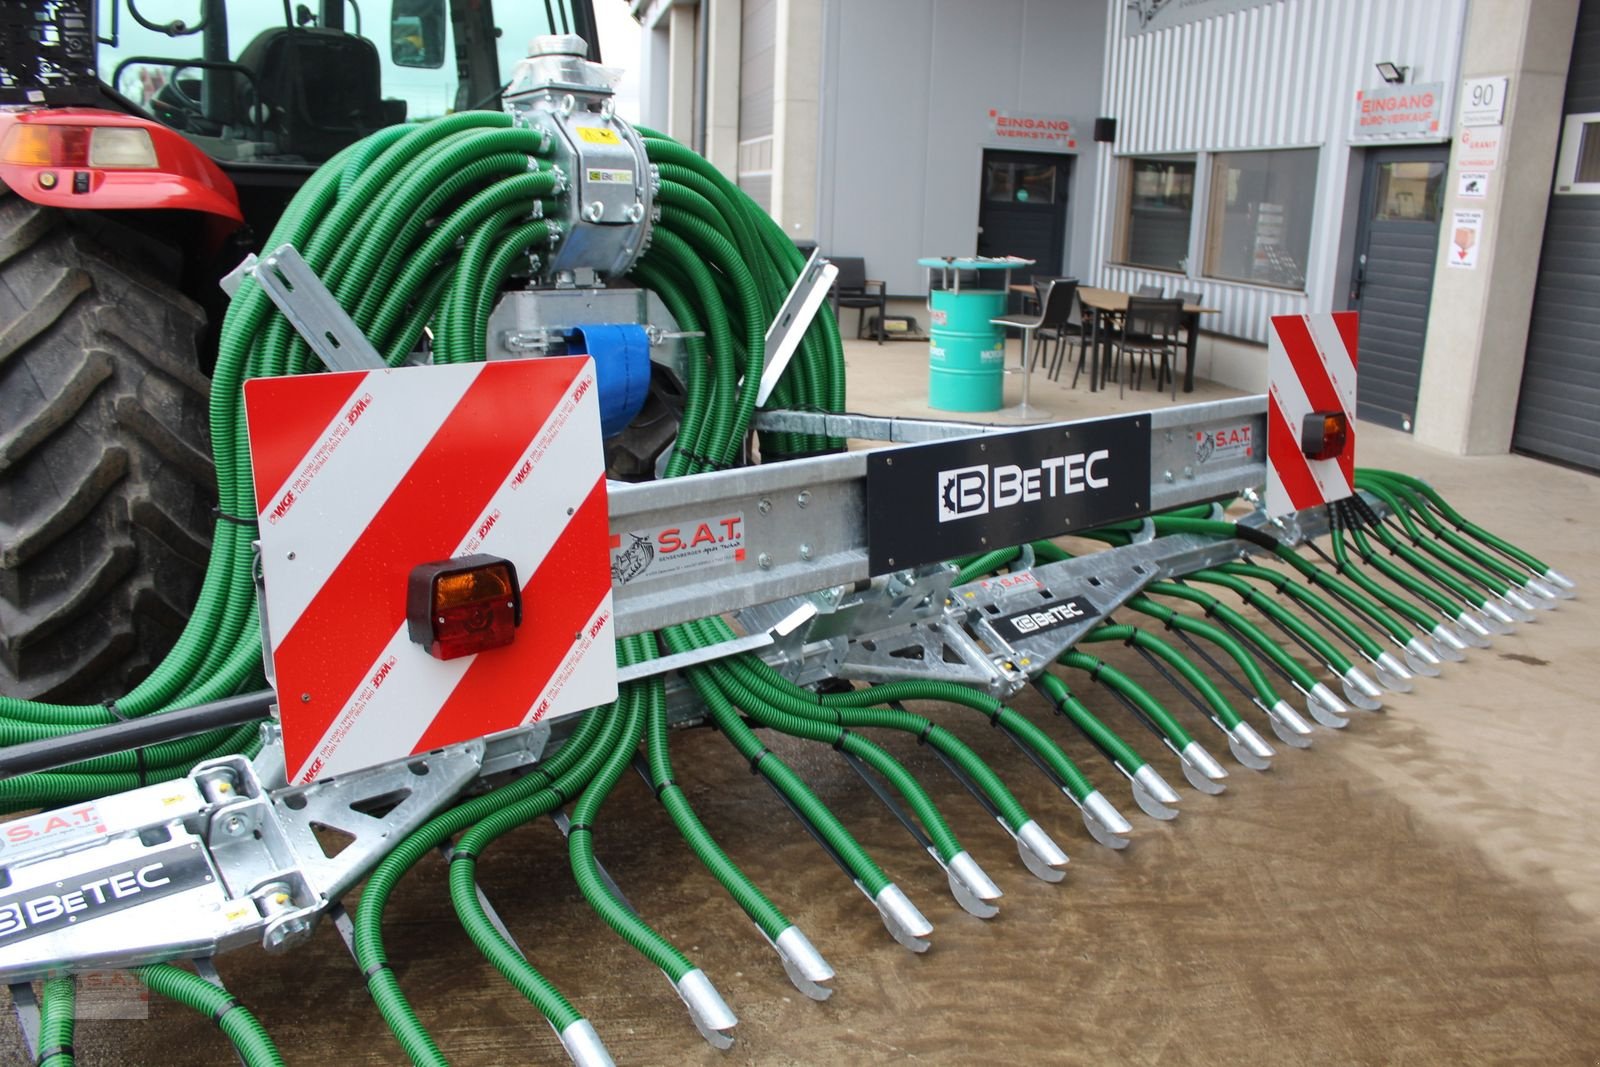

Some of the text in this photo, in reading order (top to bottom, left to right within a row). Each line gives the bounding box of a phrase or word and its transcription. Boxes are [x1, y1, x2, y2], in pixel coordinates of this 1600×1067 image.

[1362, 93, 1434, 113] EINGANG
[1472, 84, 1494, 106] 90
[997, 116, 1070, 131] EINGANG
[997, 129, 1069, 140] WERKSTATT
[1216, 426, 1250, 447] S.A.T.
[994, 449, 1109, 508] BETEC
[658, 517, 742, 553] S.A.T.
[1031, 602, 1084, 627] BETEC
[7, 806, 98, 842] S.A.T.
[26, 863, 170, 923] BETEC
